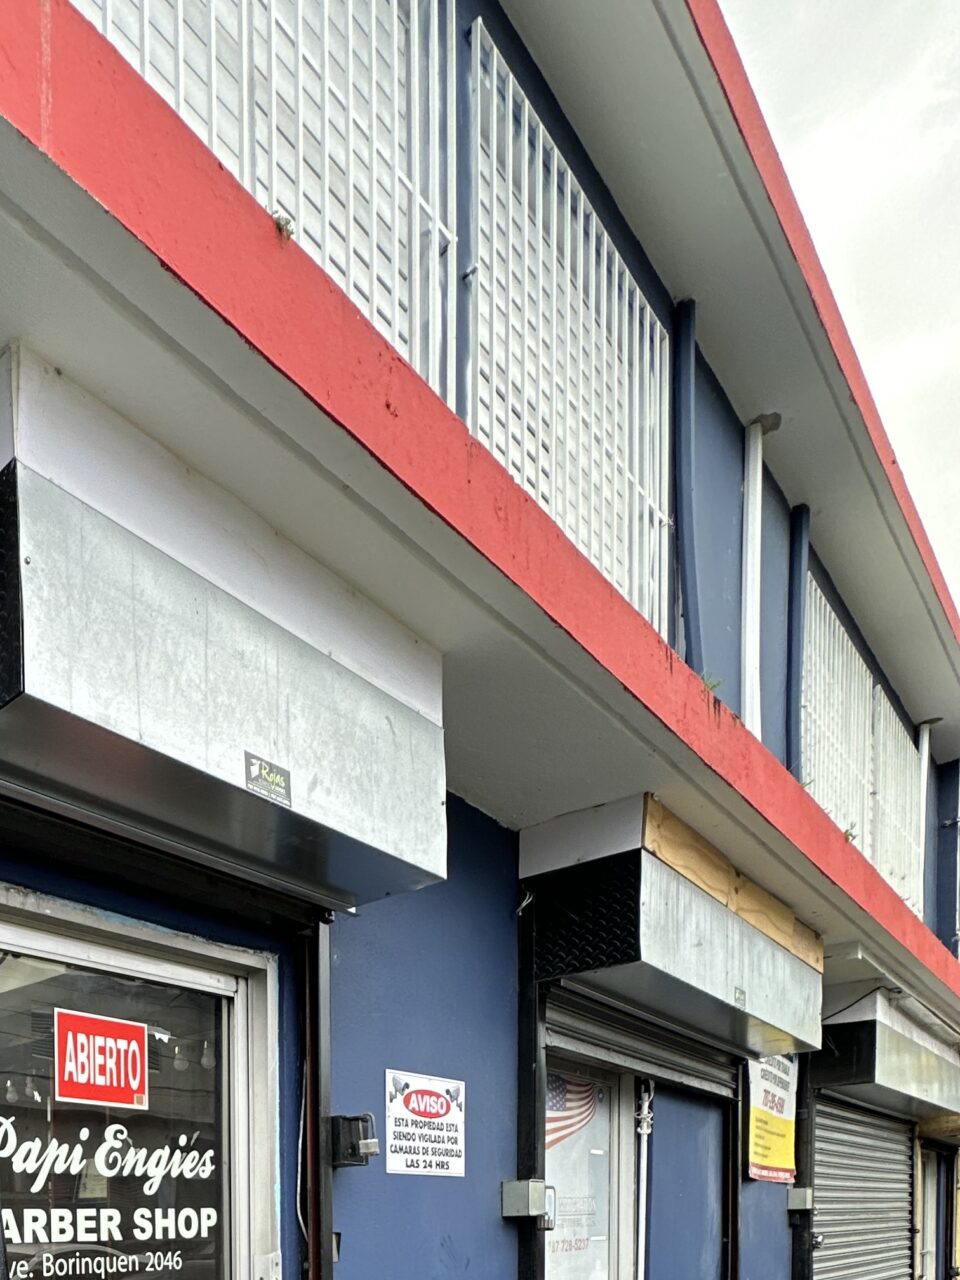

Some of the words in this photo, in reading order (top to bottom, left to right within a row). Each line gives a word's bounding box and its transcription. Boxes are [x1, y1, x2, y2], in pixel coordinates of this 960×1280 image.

[64, 1030, 141, 1091] ABIERTO
[408, 1093, 447, 1115] AVISO
[394, 1117, 409, 1128] ESTA
[411, 1119, 445, 1131] PROPIEDAD
[446, 1123, 459, 1133] ESTA
[393, 1131, 416, 1142] SIENDO
[418, 1133, 446, 1144] VIGILADA
[447, 1136, 458, 1145] POR
[390, 1144, 420, 1155] CAMARAS
[422, 1147, 429, 1156] DE
[431, 1147, 462, 1158] SEGURIDAD
[405, 1158, 420, 1168] LAS
[422, 1160, 433, 1169] 24
[435, 1161, 450, 1170] HRS
[1, 1208, 123, 1244] ARBER
[133, 1207, 218, 1240] SHOP
[42, 1251, 139, 1279] Borinquen
[145, 1250, 183, 1272] 2046
